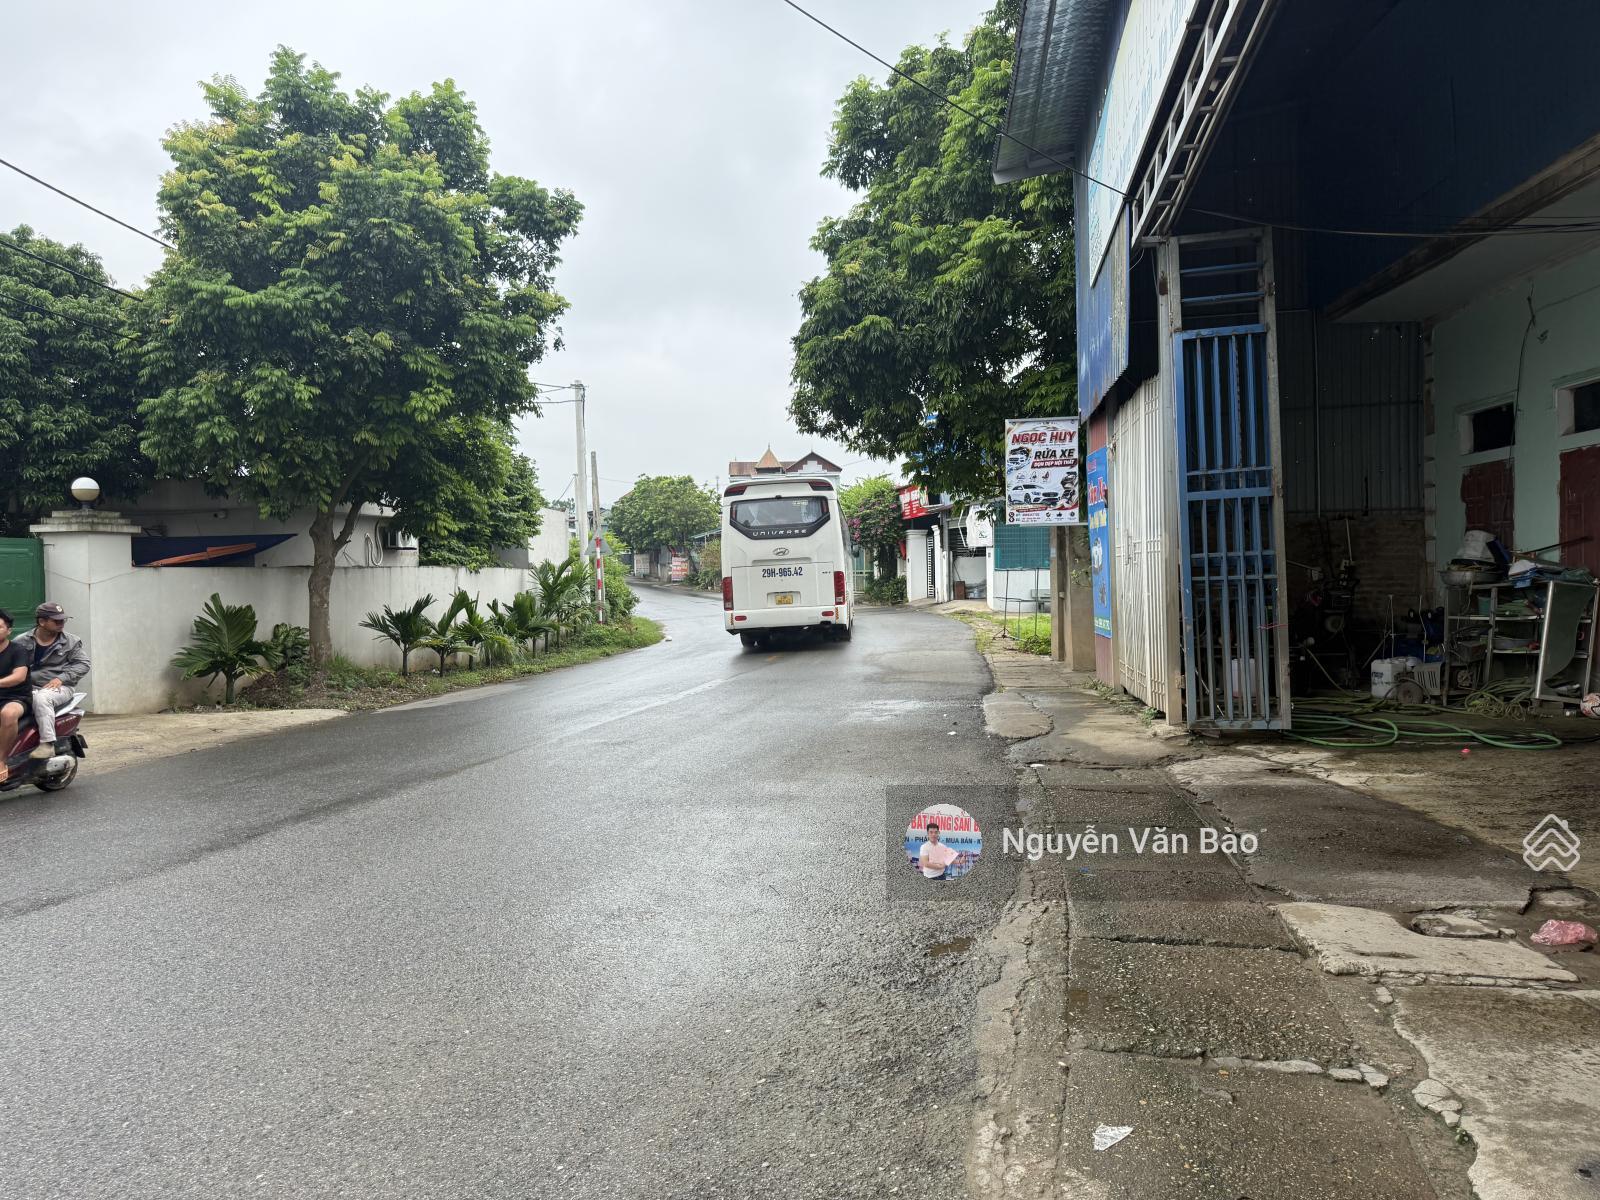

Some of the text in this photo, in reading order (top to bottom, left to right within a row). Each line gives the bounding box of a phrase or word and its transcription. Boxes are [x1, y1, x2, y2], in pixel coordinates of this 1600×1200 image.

[1012, 431, 1076, 445] NGỌC HUY
[1034, 448, 1075, 459] RỬA XE
[752, 529, 807, 537] UNIVERSE
[762, 567, 803, 578] 29H-965.42
